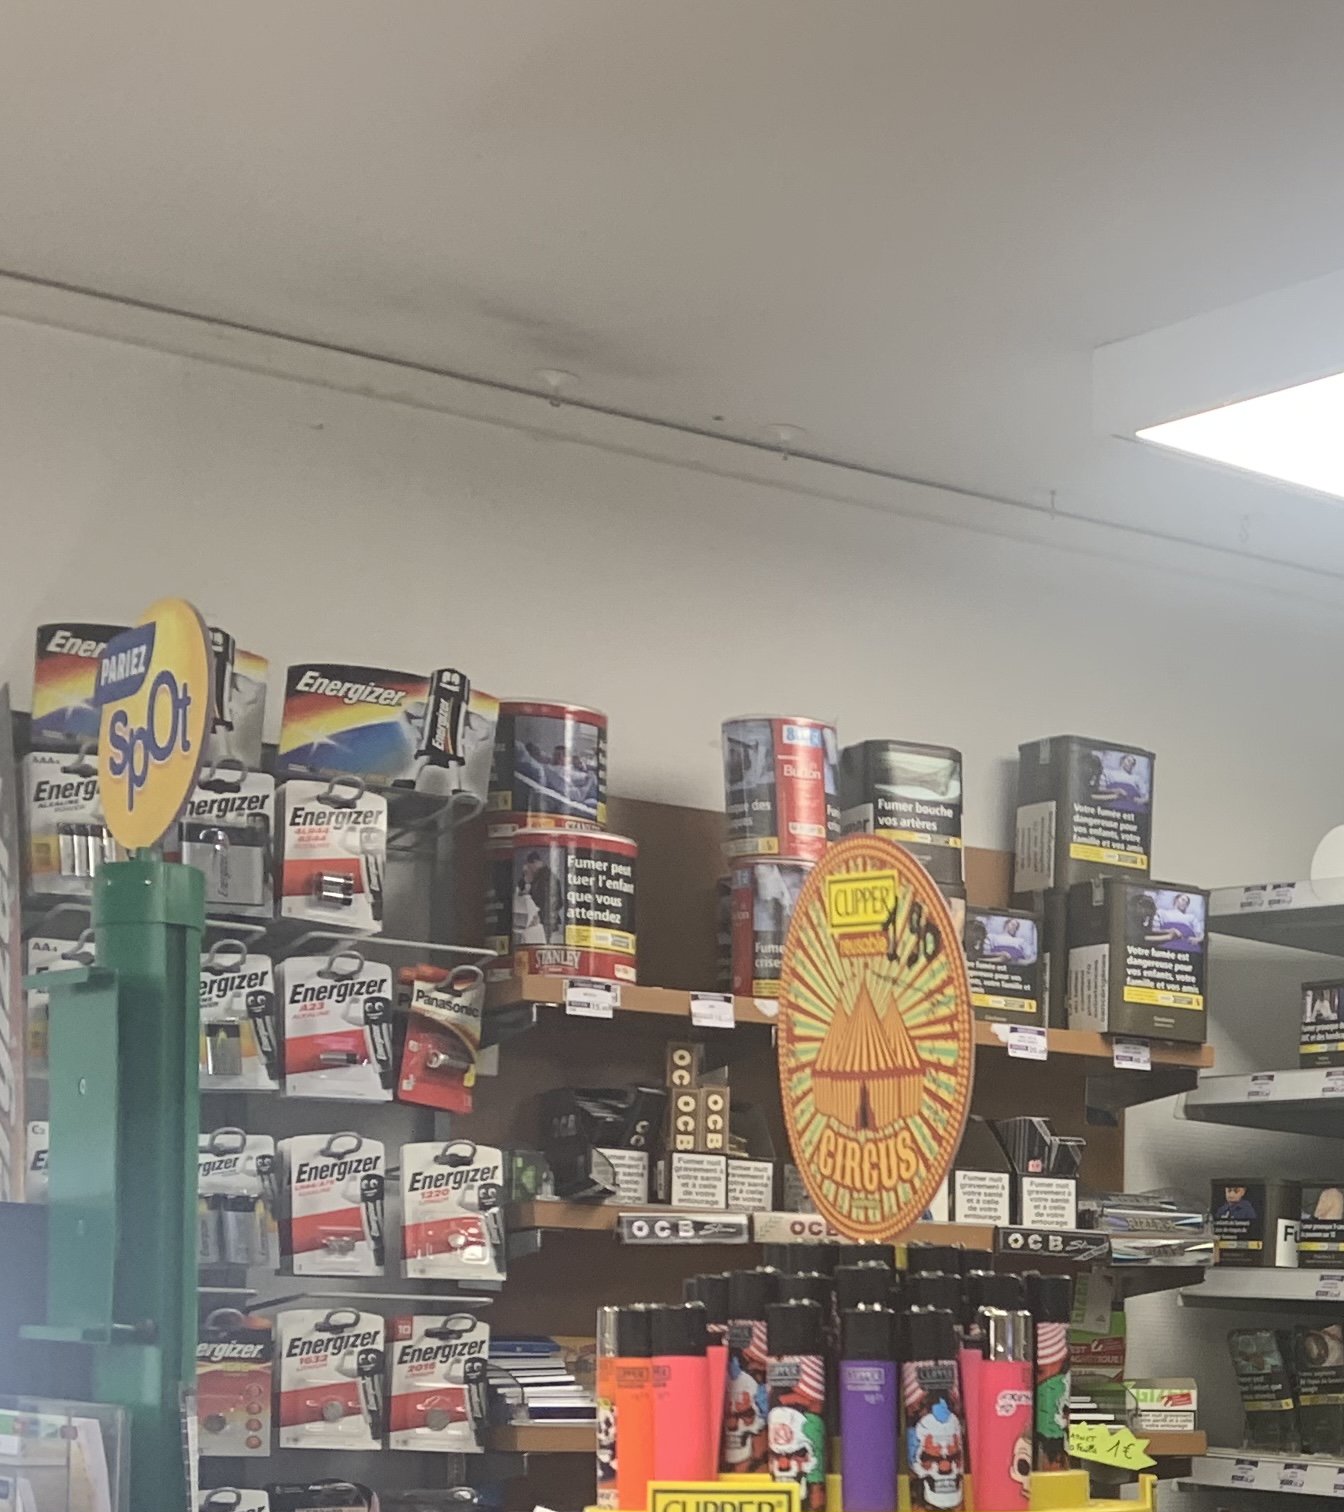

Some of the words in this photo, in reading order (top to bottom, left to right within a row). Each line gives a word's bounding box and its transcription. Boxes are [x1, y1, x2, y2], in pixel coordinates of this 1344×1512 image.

[101, 645, 147, 686] PARIEZ
[296, 671, 408, 709] Energizer
[289, 807, 383, 831] Energizer
[877, 798, 913, 813] Fumer
[915, 801, 954, 818] bouche
[877, 814, 897, 828] vos
[899, 816, 937, 832] artères
[567, 855, 609, 873] Fumer
[567, 872, 594, 888] tuer
[567, 891, 592, 909] que
[595, 892, 623, 908] vous
[834, 883, 894, 920] CLIPPER
[567, 906, 621, 925] attendez
[535, 949, 582, 971] STANLEY
[290, 977, 387, 1004] Energizer
[415, 989, 480, 1019] Panasonic
[675, 1094, 696, 1151] OCB
[706, 1092, 724, 1150] OCB
[296, 1155, 381, 1184] Energizer
[818, 1125, 920, 1194] CIRCUS
[408, 1164, 499, 1192] Energizer
[632, 1220, 695, 1237] OCB
[1008, 1233, 1063, 1251] OCB
[286, 1328, 381, 1359] Energizer
[397, 1337, 486, 1365] Energizer
